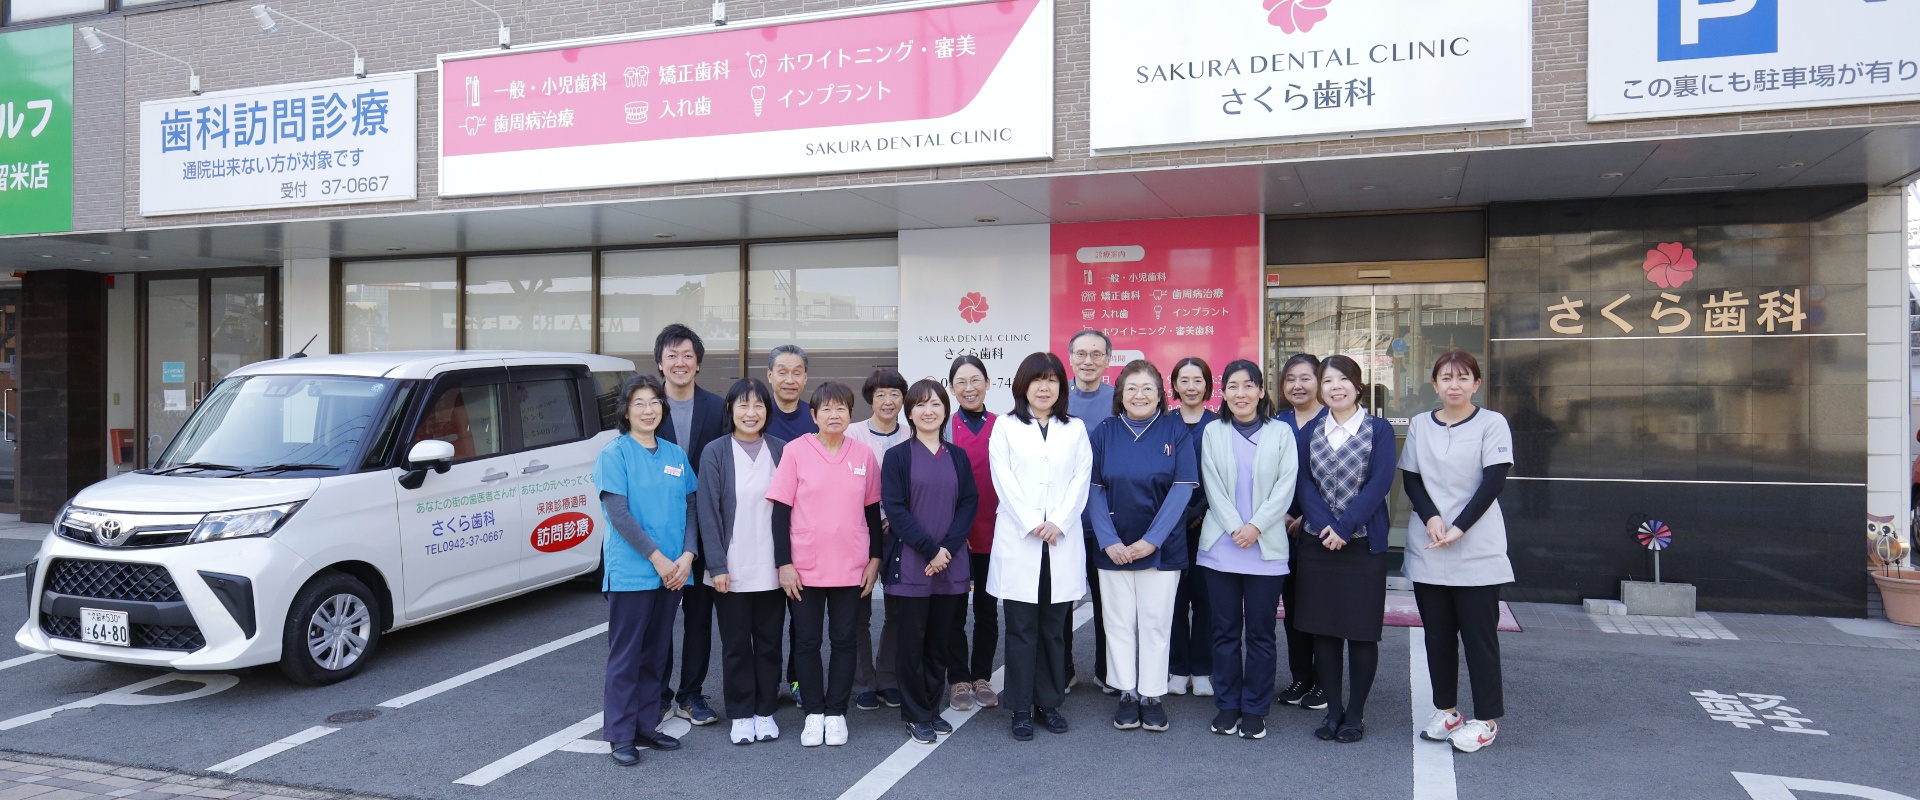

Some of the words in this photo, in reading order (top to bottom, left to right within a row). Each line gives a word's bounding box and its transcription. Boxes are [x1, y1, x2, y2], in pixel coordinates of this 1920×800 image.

[777, 34, 976, 74] ホワイトニング・審美
[1136, 57, 1241, 84] SAKURA
[1250, 47, 1360, 74] DENTAL
[1368, 36, 1470, 64] CLINIC
[658, 59, 731, 85] 矯正歯科
[1623, 59, 1919, 99] この裏にも駐車場が有り
[493, 72, 608, 100] 一般・小児歯科
[777, 80, 891, 109] インプラント
[1220, 77, 1376, 115] さくら歯科
[160, 88, 390, 154] 歯科訪問診療
[493, 107, 575, 134] 歯周病治療
[659, 96, 712, 120] 入れ歯
[805, 139, 872, 156] SAKURA
[877, 133, 945, 151] DENTAL
[950, 128, 1012, 145] CLINIC
[182, 147, 364, 180] 通院出来ない方が対象です
[280, 181, 307, 198] 受付
[321, 176, 389, 195] 37-0667
[1100, 290, 1141, 301] 矯正歯科
[1172, 288, 1224, 300] 歯周病治療
[1101, 309, 1129, 319] 入れ歯
[1172, 307, 1229, 318] インプラント
[1547, 289, 1807, 334] さくら歯科
[918, 335, 955, 343] SAKURA
[957, 334, 995, 343] DENTAL
[997, 333, 1031, 342] CLINIC
[944, 347, 1004, 360] さくら歯科
[416, 487, 517, 513] あなたの街の歯医者さんが
[536, 494, 587, 516] 保険診療適用
[432, 509, 495, 536] さくら歯科
[536, 517, 589, 547] 訪問診療
[92, 623, 127, 642] 64-80
